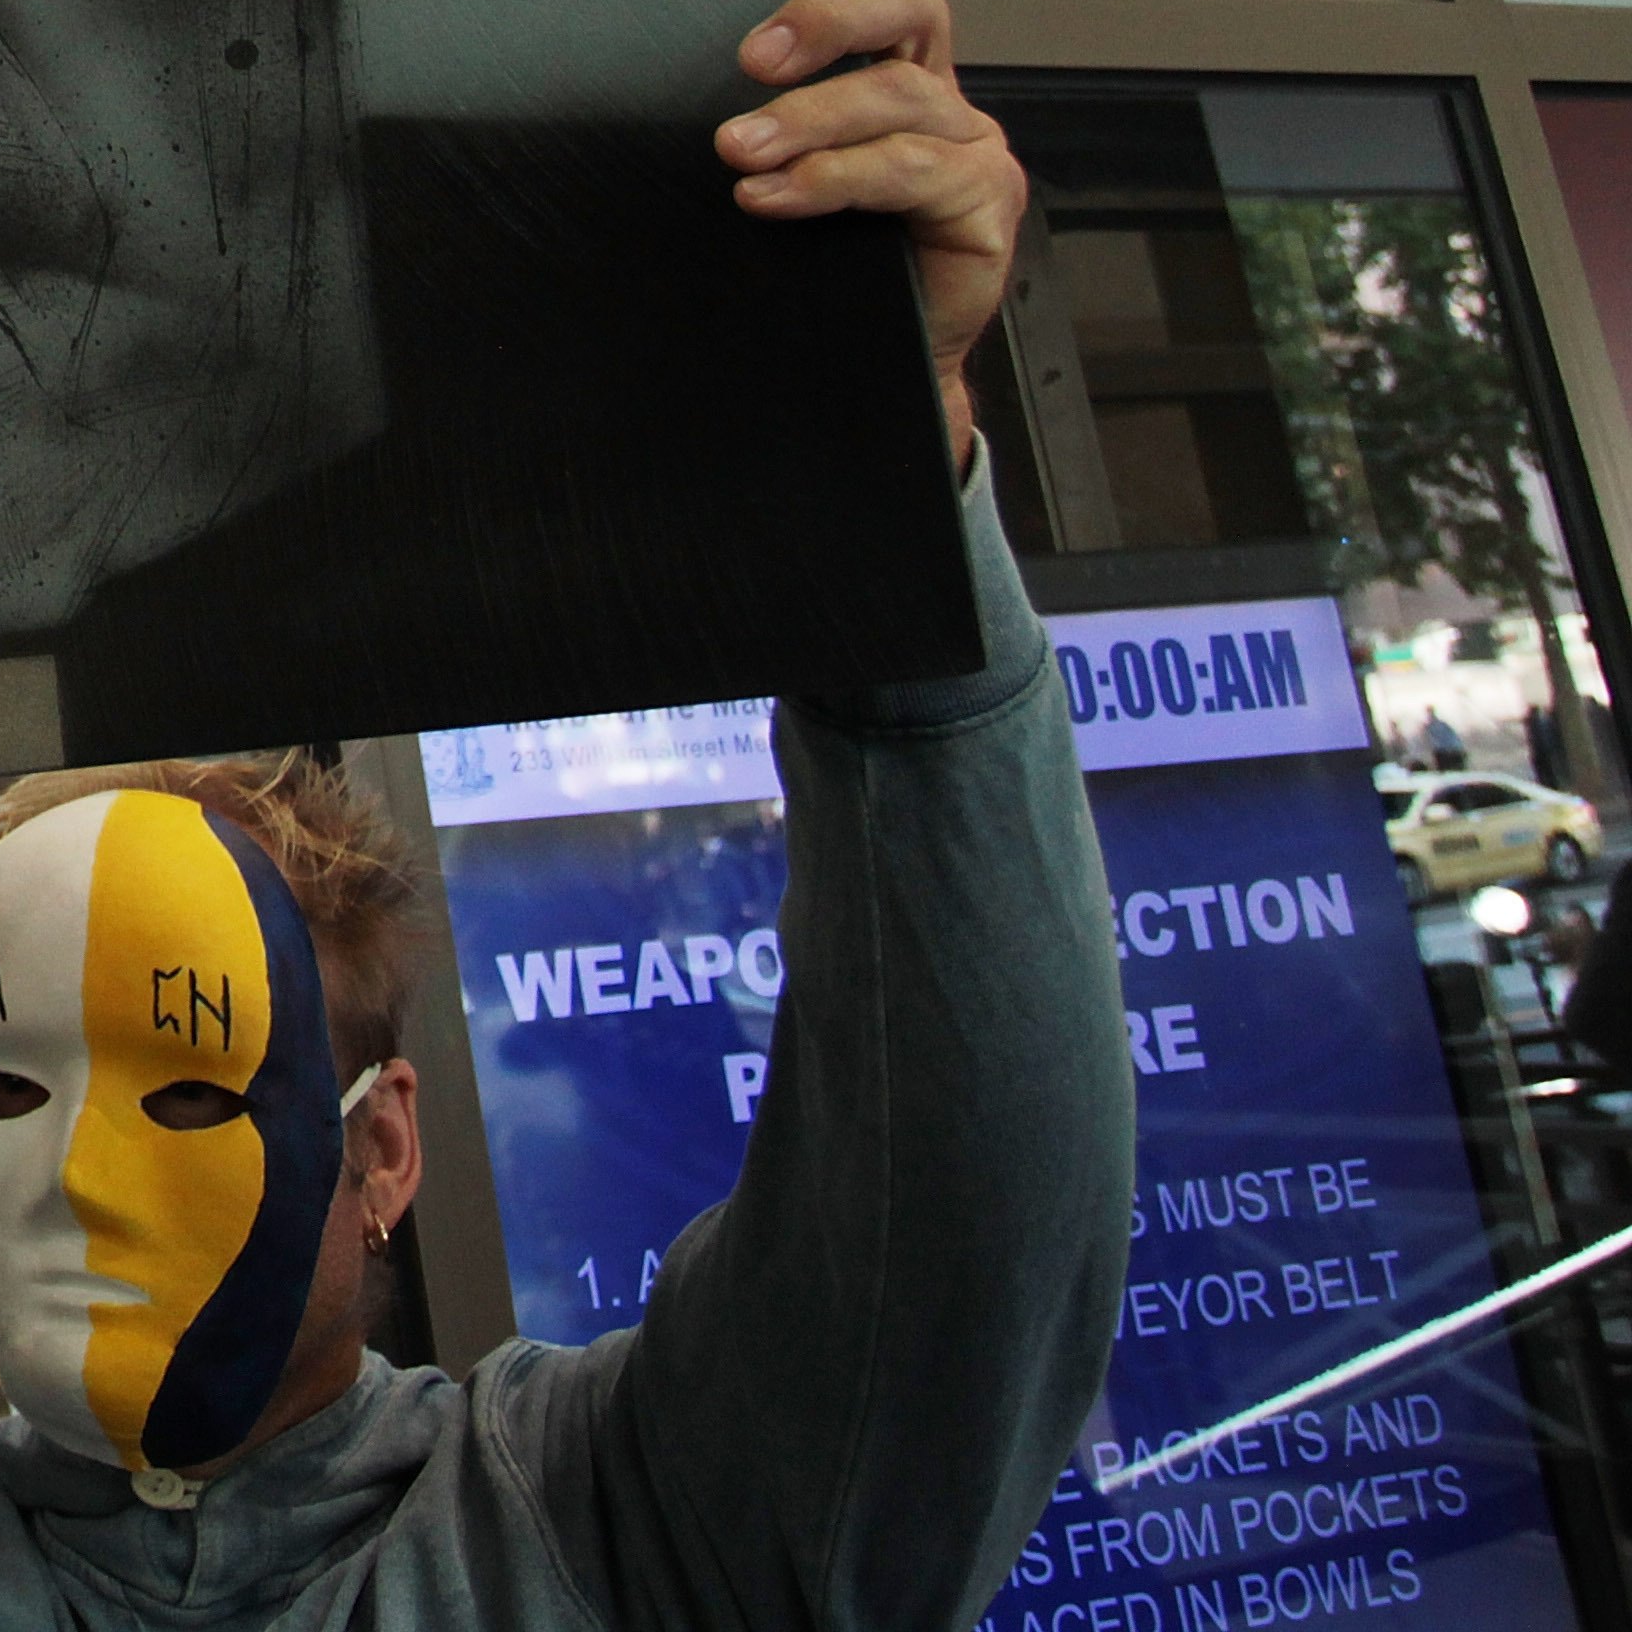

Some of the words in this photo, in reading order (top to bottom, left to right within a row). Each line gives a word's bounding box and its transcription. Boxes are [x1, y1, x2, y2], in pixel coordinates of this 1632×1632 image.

[1156, 1167, 1294, 1234] MUST
[1306, 1157, 1378, 1214] BE
[1280, 1250, 1400, 1315] BELT
[1092, 1409, 1330, 1495] PACKETS
[1342, 1393, 1444, 1457] AND
[1065, 1502, 1222, 1579] FROM
[1229, 1465, 1469, 1553] POCKETS
[1239, 1548, 1423, 1628] BOWLS
